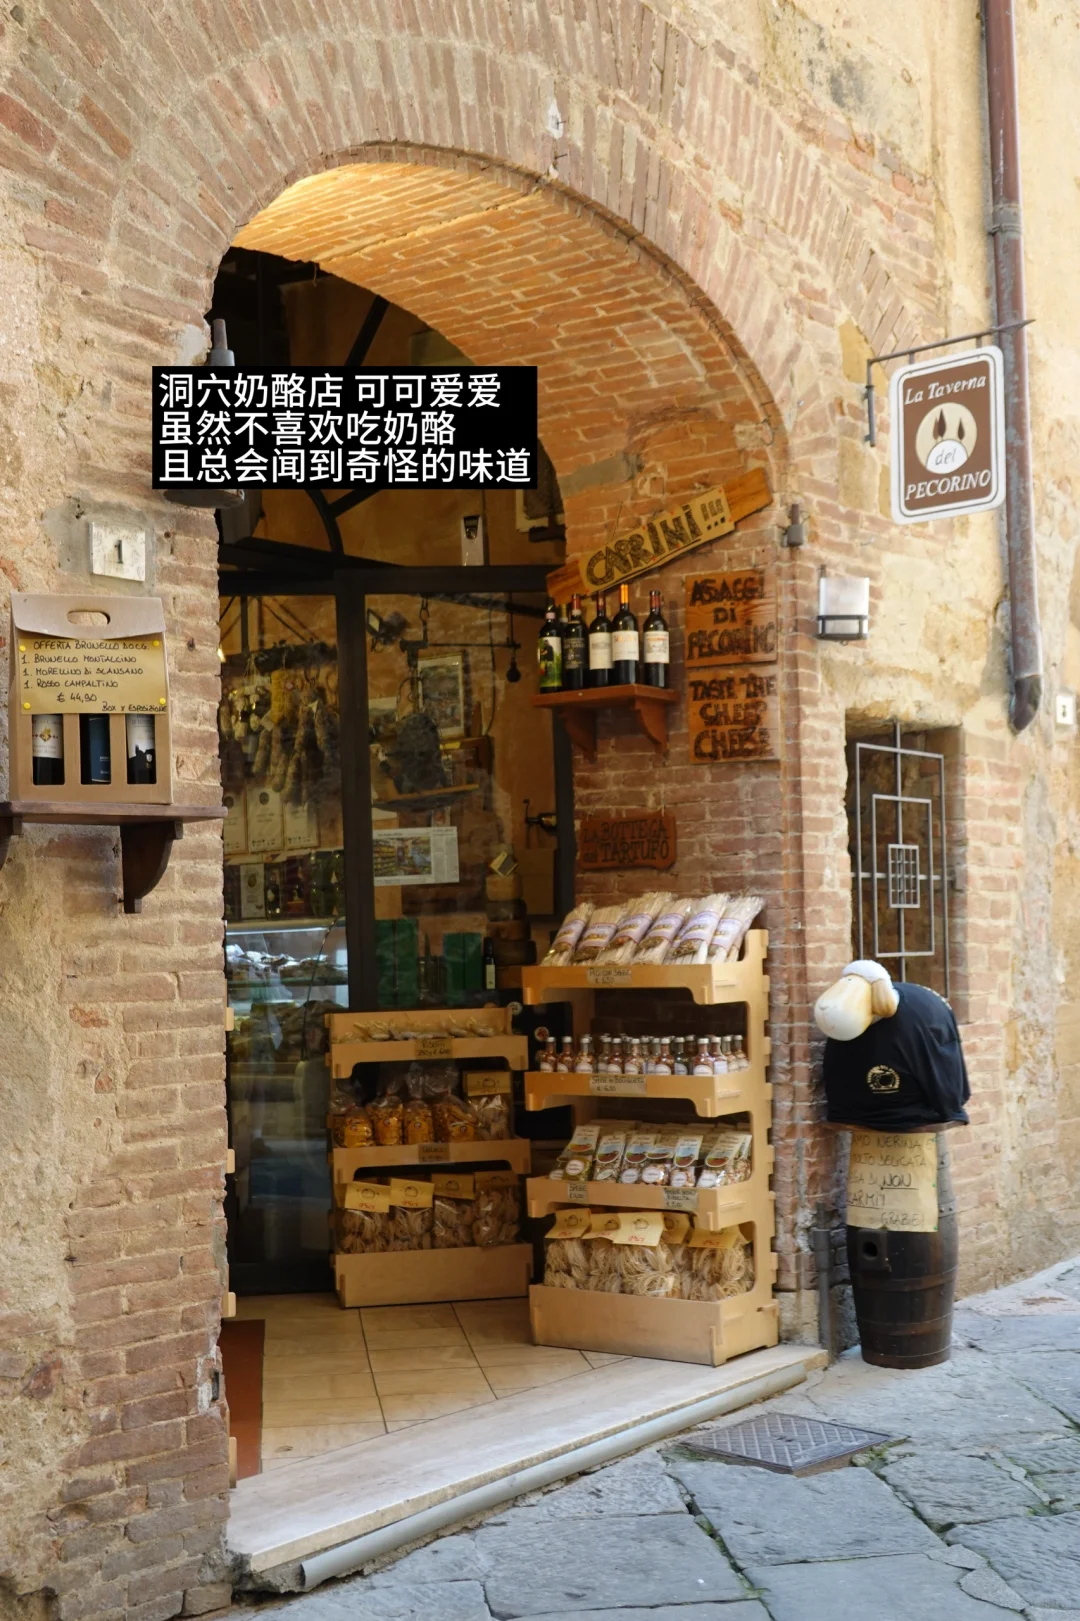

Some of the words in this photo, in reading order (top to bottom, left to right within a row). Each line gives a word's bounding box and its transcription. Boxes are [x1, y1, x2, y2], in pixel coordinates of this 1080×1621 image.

[904, 389, 923, 405] La
[927, 375, 987, 400] Taverna
[935, 448, 955, 466] del
[904, 469, 992, 501] PECORINO
[114, 539, 124, 565] 1
[33, 640, 71, 650] OFFERTA
[74, 640, 120, 650] BRUNELLO
[34, 653, 78, 664] BRUNELLO
[96, 667, 144, 675] SCANSANO
[689, 676, 738, 701] TASTE
[739, 673, 778, 698] THE
[70, 693, 98, 703] 44,90
[600, 839, 670, 864] TARTUFO
[882, 1173, 912, 1187] NON
